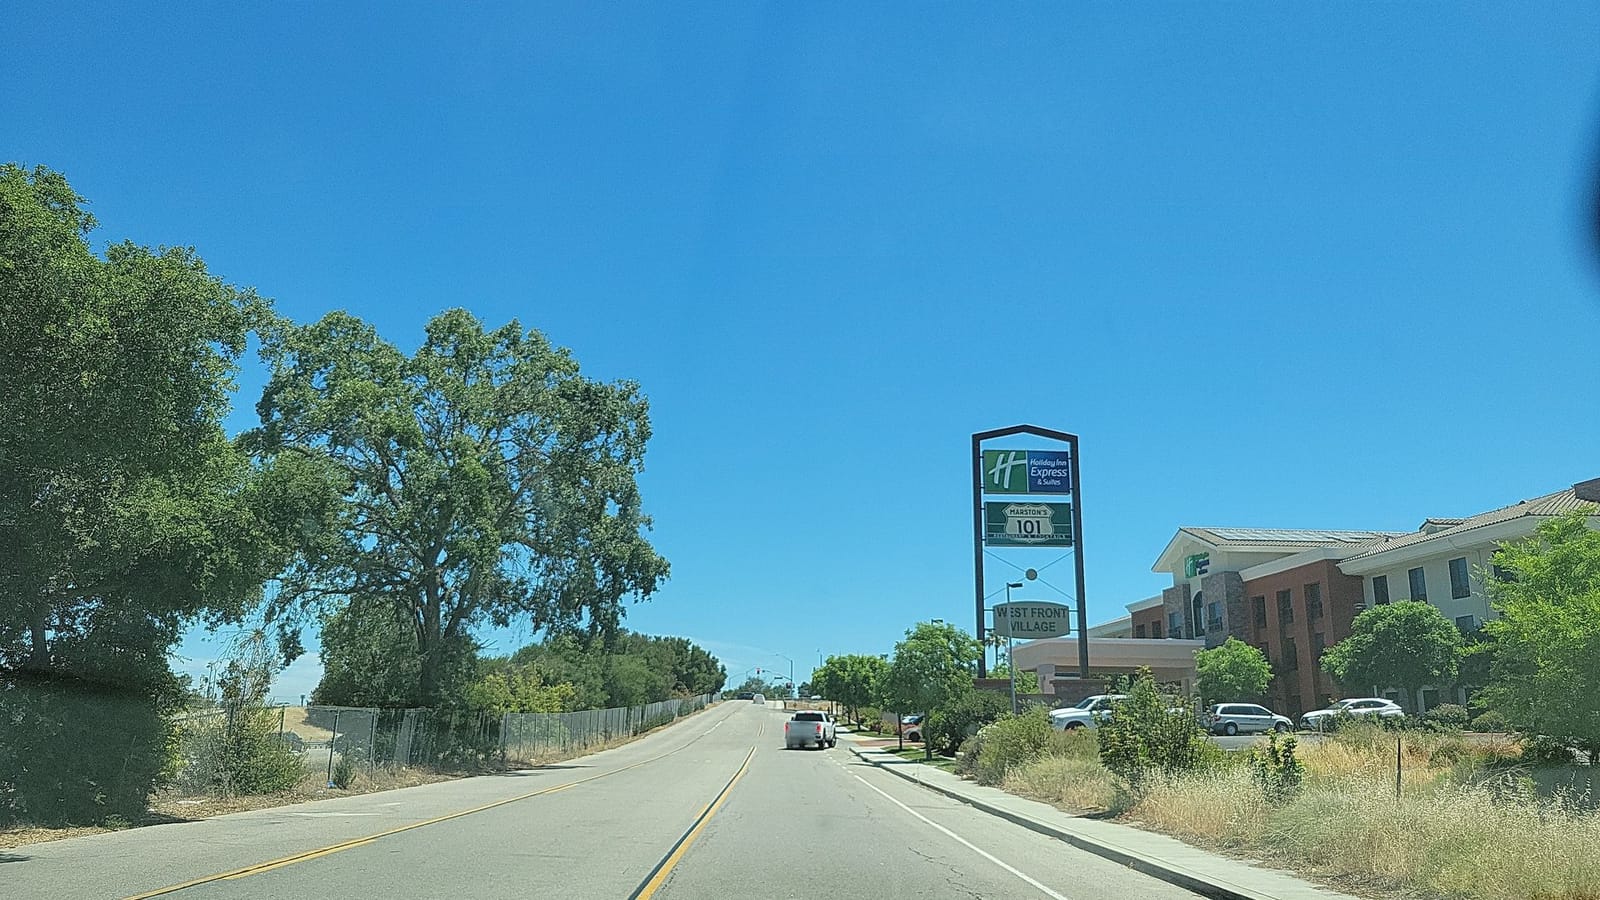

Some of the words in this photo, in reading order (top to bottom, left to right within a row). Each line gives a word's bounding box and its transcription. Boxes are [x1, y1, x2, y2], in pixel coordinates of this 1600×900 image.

[1030, 458, 1055, 468] Holiday
[1056, 458, 1067, 466] Inn
[1030, 467, 1067, 478] Express
[1043, 478, 1061, 486] Suites
[1016, 520, 1041, 534] 101
[996, 607, 1028, 618] WEST
[1031, 607, 1067, 618] FRONT
[1010, 621, 1057, 632] VILLAGE
